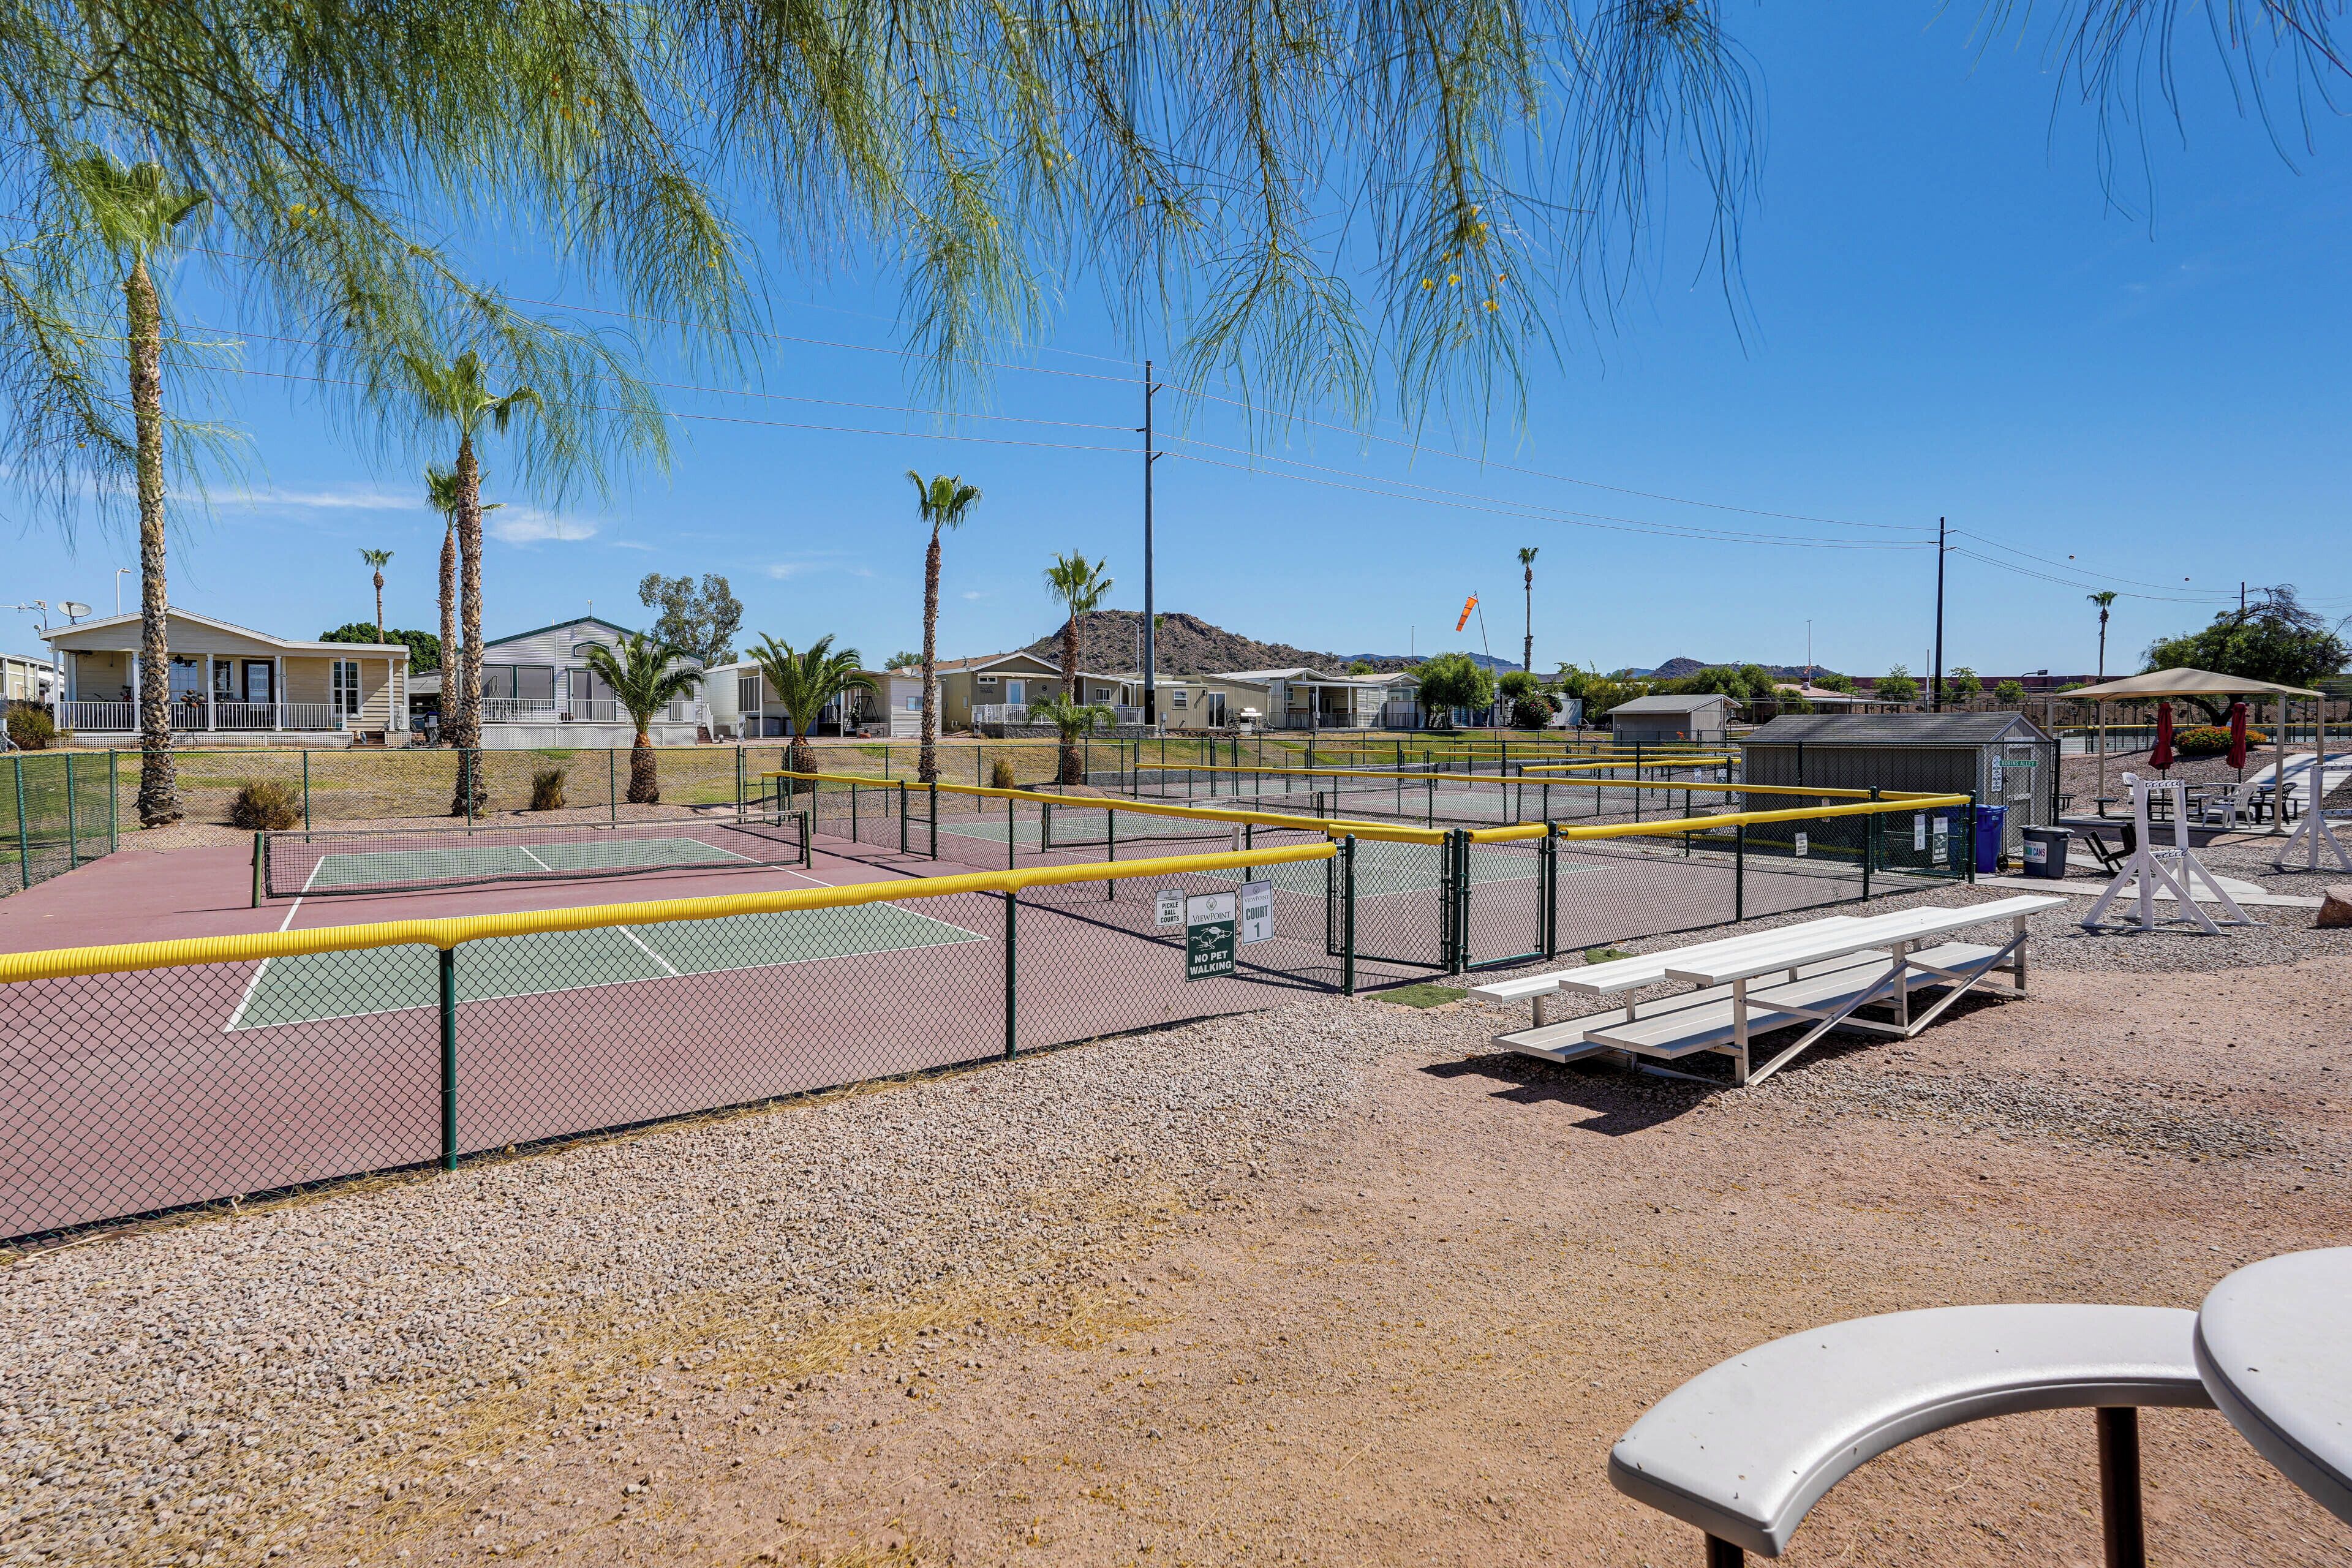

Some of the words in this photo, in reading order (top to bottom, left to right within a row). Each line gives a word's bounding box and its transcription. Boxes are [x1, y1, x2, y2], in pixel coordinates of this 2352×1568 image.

[2033, 847, 2046, 857] CANS
[1246, 905, 1268, 921] COURT
[1254, 921, 1260, 938] 1
[1194, 953, 1208, 963] NO
[1210, 950, 1228, 961] PET
[1189, 960, 1232, 976] WALKING
